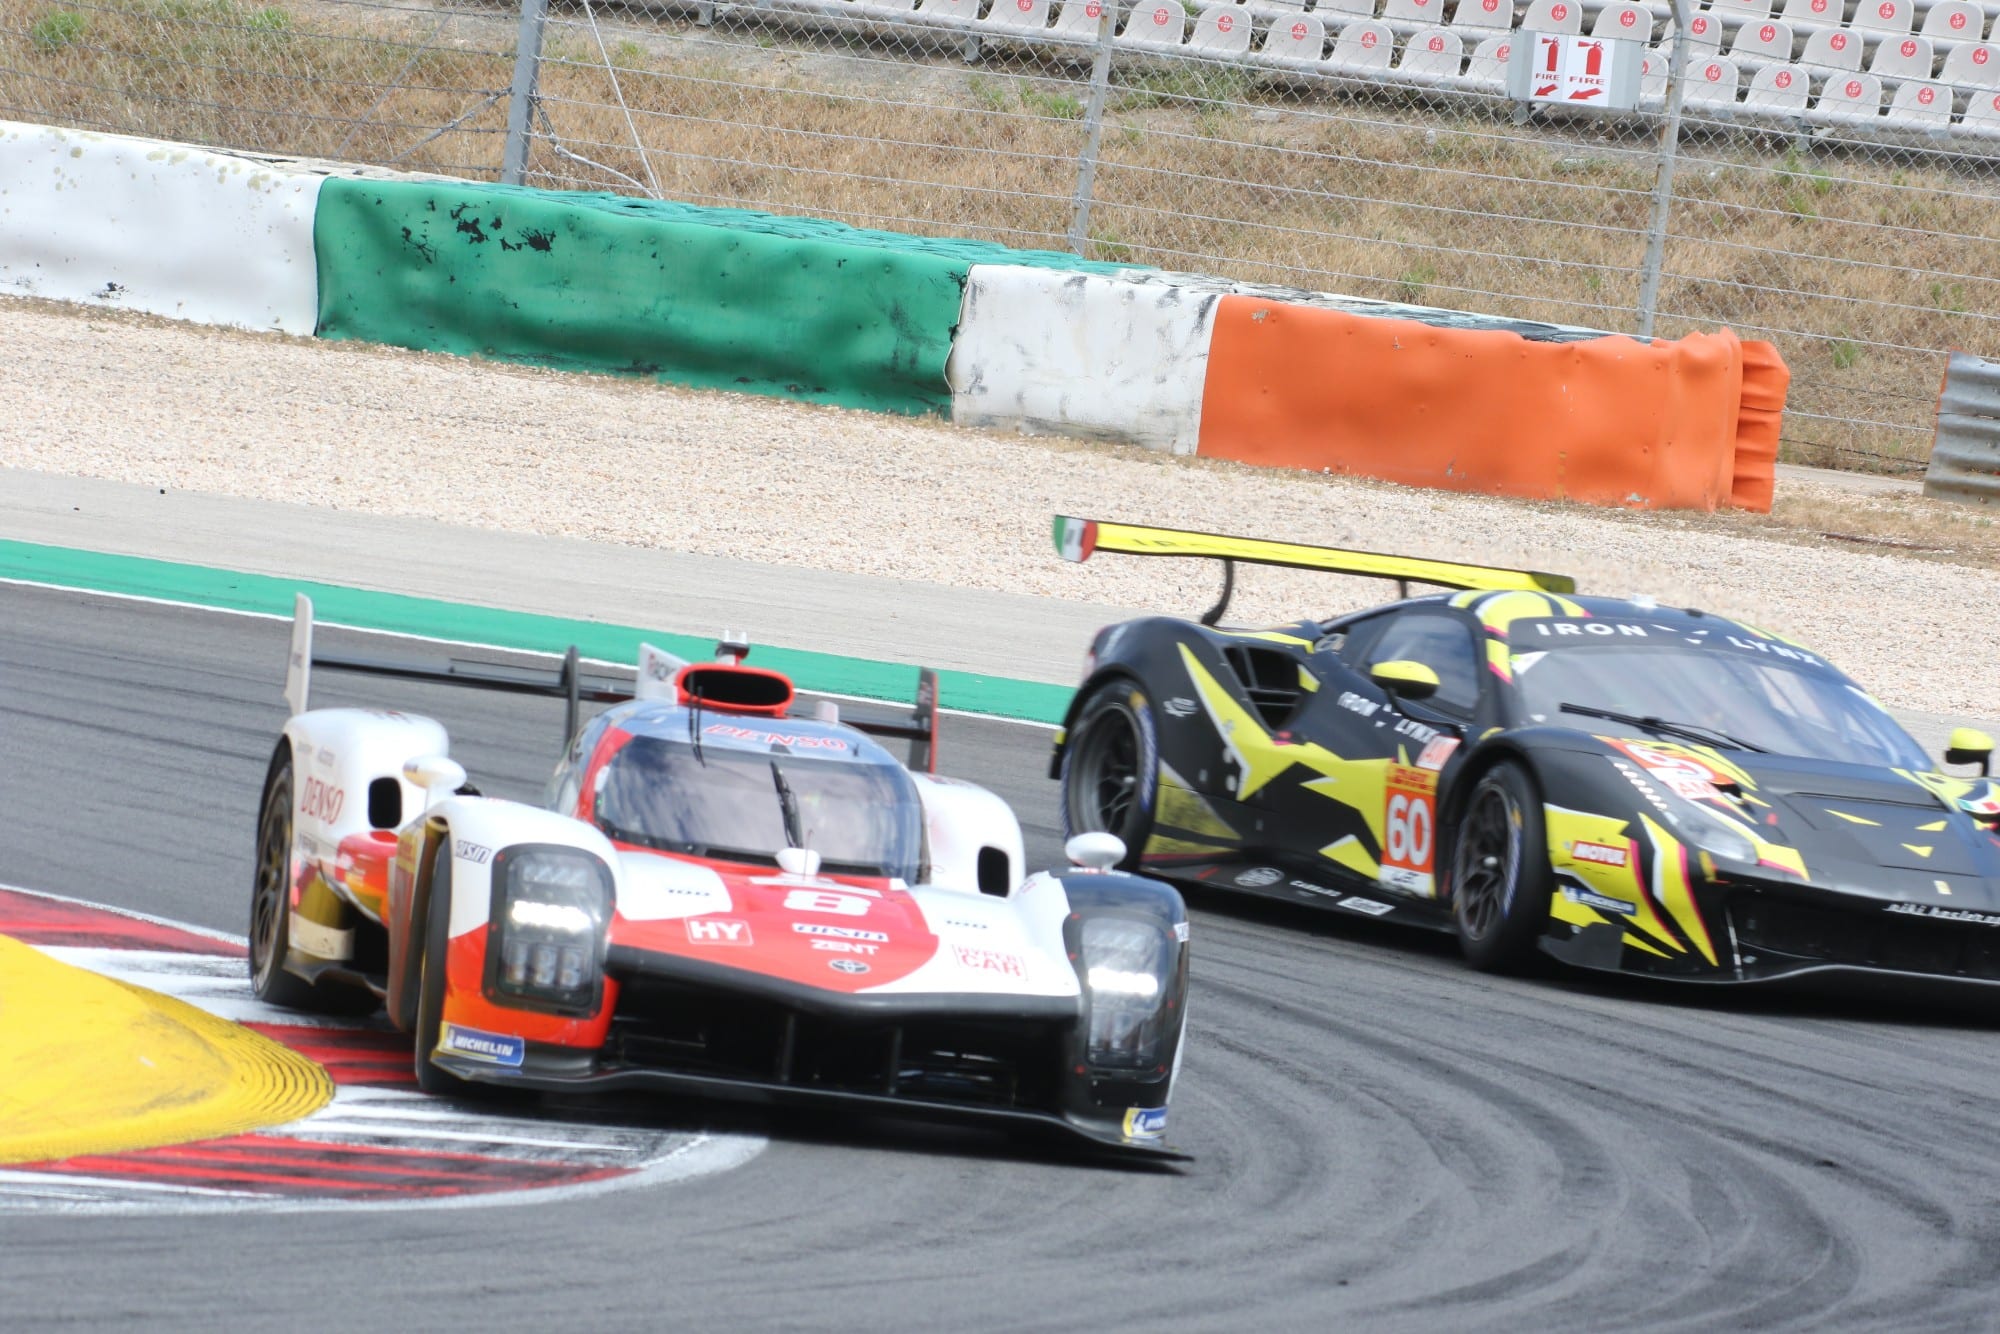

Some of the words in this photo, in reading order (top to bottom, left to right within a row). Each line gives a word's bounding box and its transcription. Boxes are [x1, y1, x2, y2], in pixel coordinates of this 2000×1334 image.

[1535, 72, 1561, 80] FIRE
[1569, 76, 1606, 85] FIRE
[1535, 623, 1648, 637] IRON
[1726, 636, 1825, 667] LYNX
[704, 723, 848, 752] DENSO
[301, 776, 345, 825] DENSO
[1387, 794, 1432, 866] 60
[1574, 843, 1626, 866] MOTUL
[783, 890, 872, 916] 8
[690, 921, 743, 940] HY
[810, 939, 880, 955] ZENT
[961, 953, 1021, 977] CAR
[455, 1036, 514, 1057] MICHELIN
